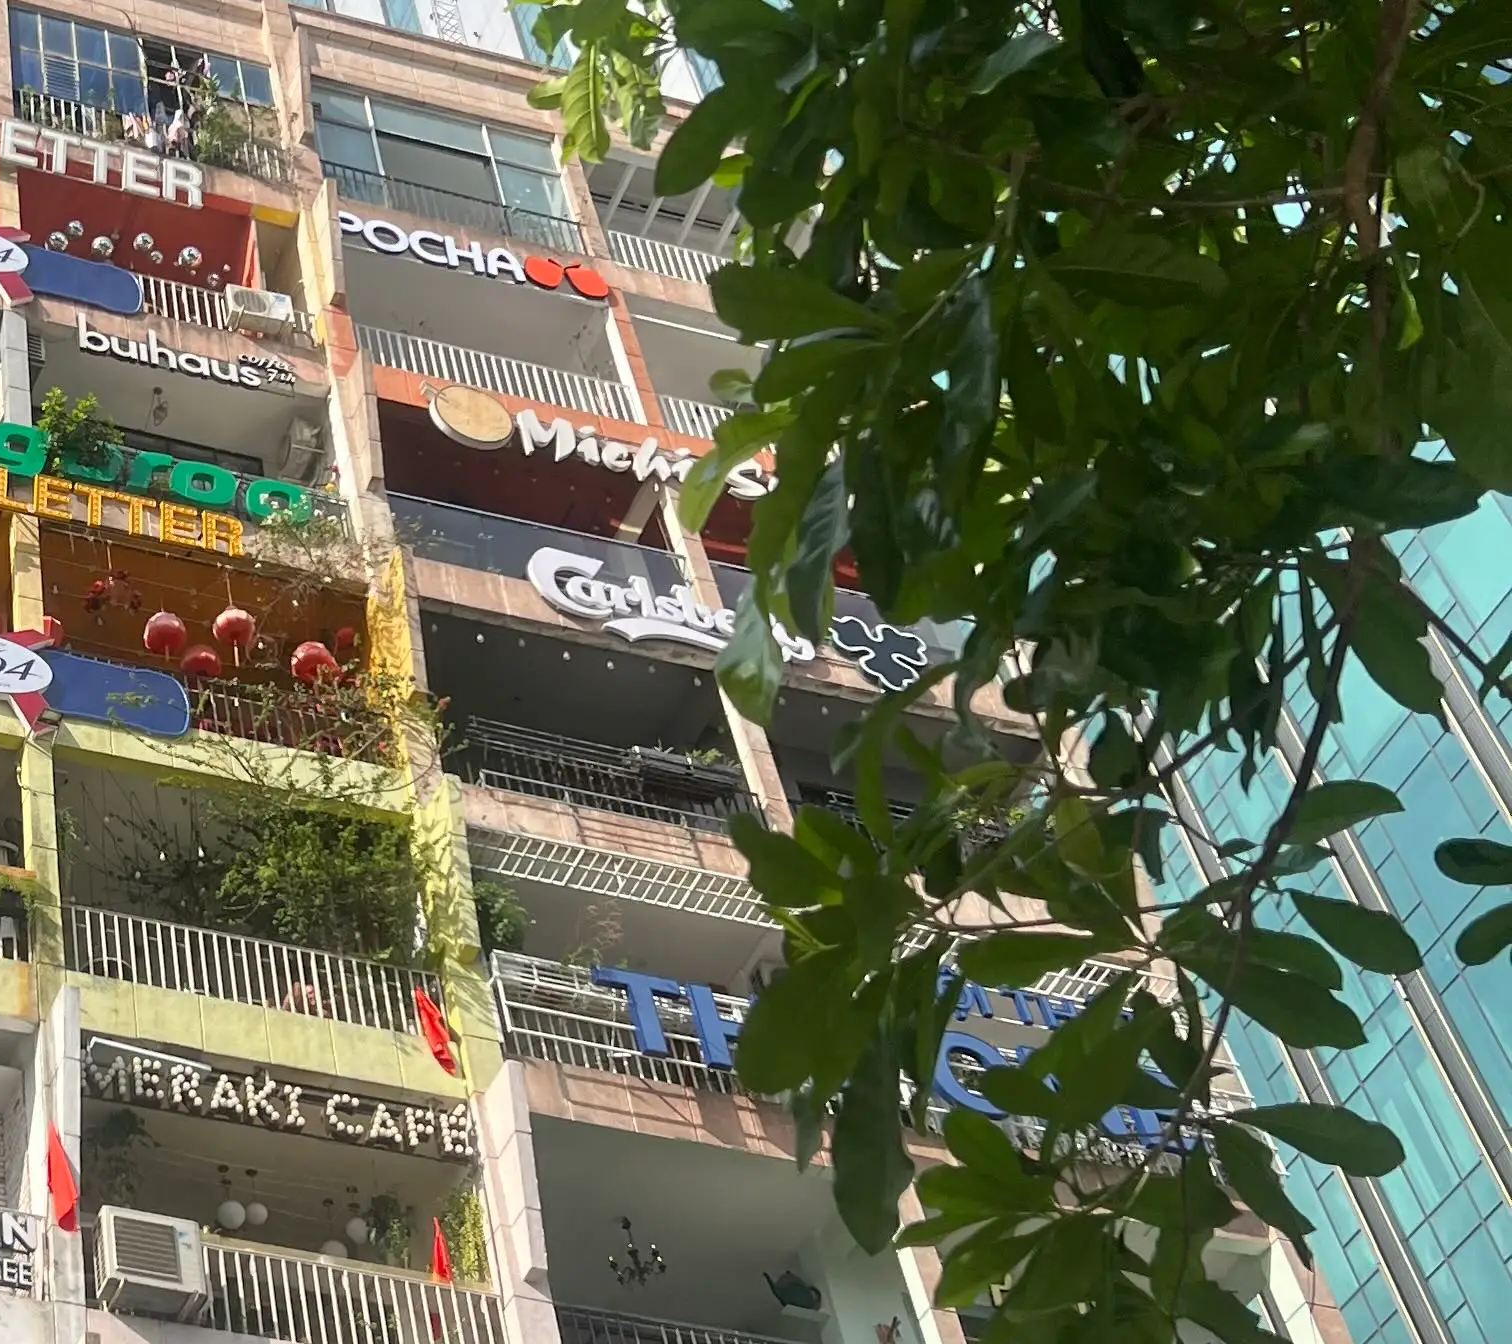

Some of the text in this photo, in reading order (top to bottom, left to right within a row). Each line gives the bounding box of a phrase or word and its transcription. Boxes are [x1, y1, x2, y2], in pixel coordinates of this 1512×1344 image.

[337, 211, 527, 283] POCHA
[76, 312, 262, 388] buihaus
[80, 1047, 306, 1127] MERAKI
